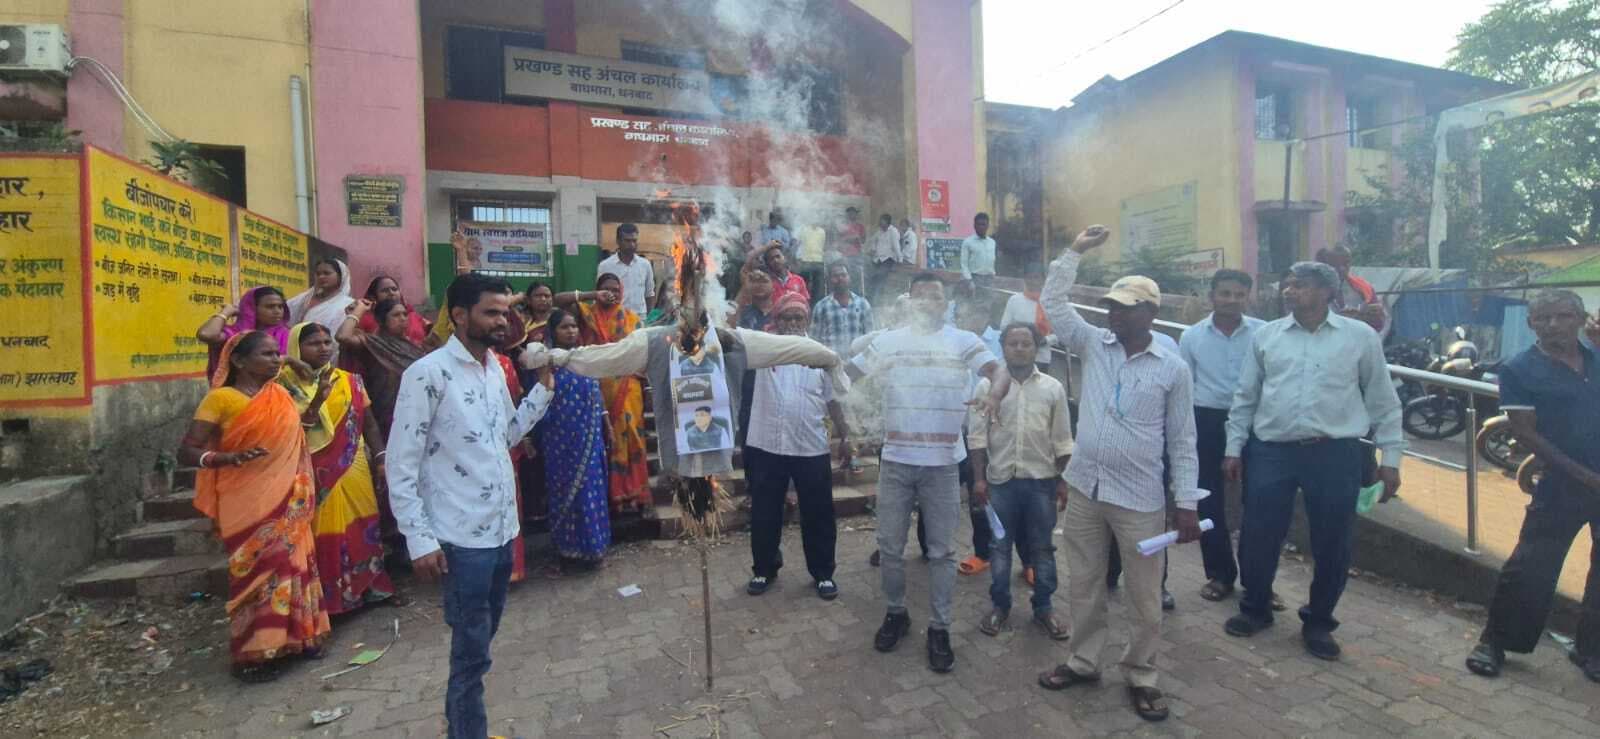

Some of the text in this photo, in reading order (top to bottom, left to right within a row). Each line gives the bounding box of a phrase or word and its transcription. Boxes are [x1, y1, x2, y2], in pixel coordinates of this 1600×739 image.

[512, 57, 563, 76] प्रखण्ड
[567, 63, 592, 80] सह
[596, 65, 636, 85] अंचल
[12, 254, 64, 278] अंकुरण
[15, 278, 64, 299] पैदावार
[25, 371, 77, 387] झारखण्ड
